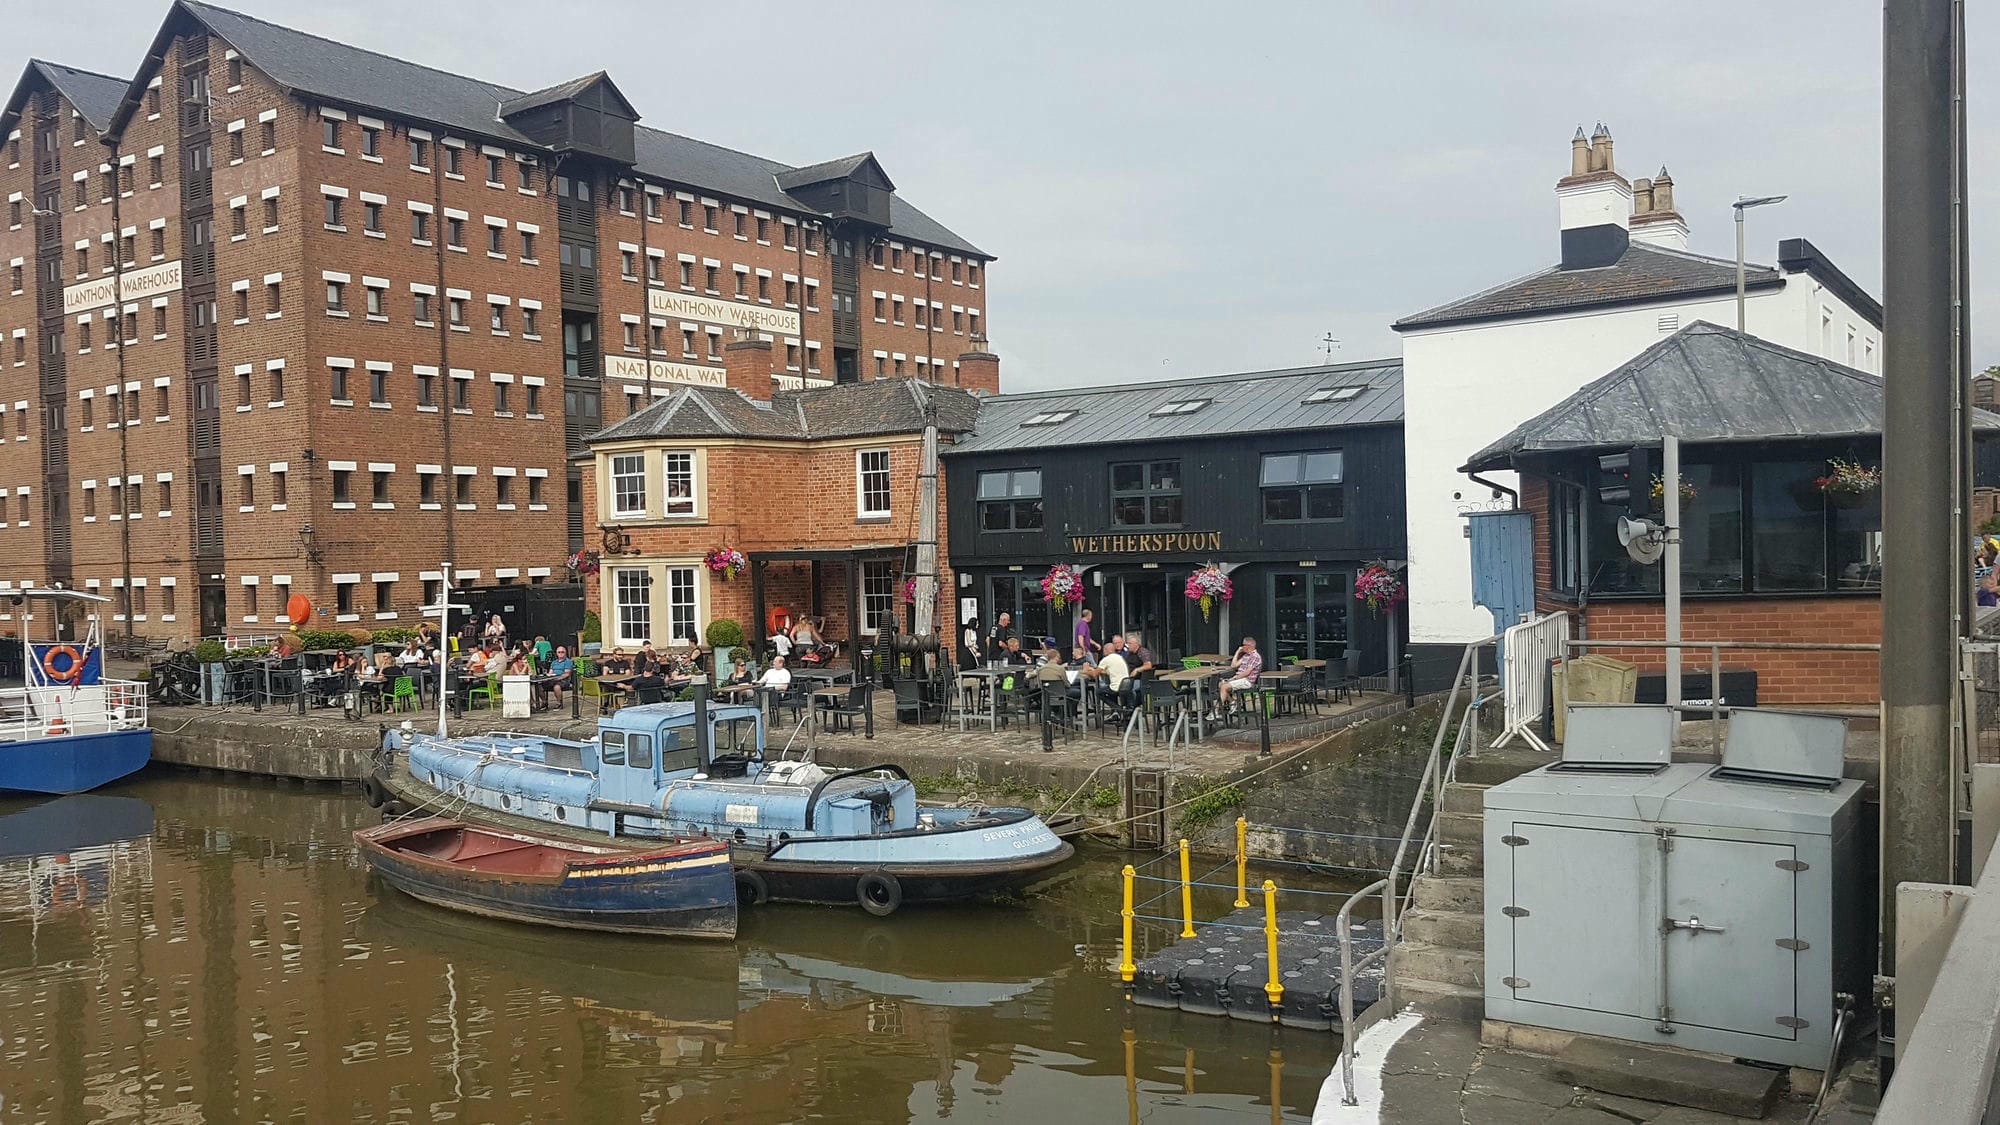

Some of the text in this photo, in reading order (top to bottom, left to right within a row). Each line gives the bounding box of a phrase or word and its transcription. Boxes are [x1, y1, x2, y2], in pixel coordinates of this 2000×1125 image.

[122, 268, 180, 293] WAREHOUSE
[653, 295, 796, 330] LLANTHONY WAREHOUSE
[1072, 532, 1221, 553] WETHERSPOON
